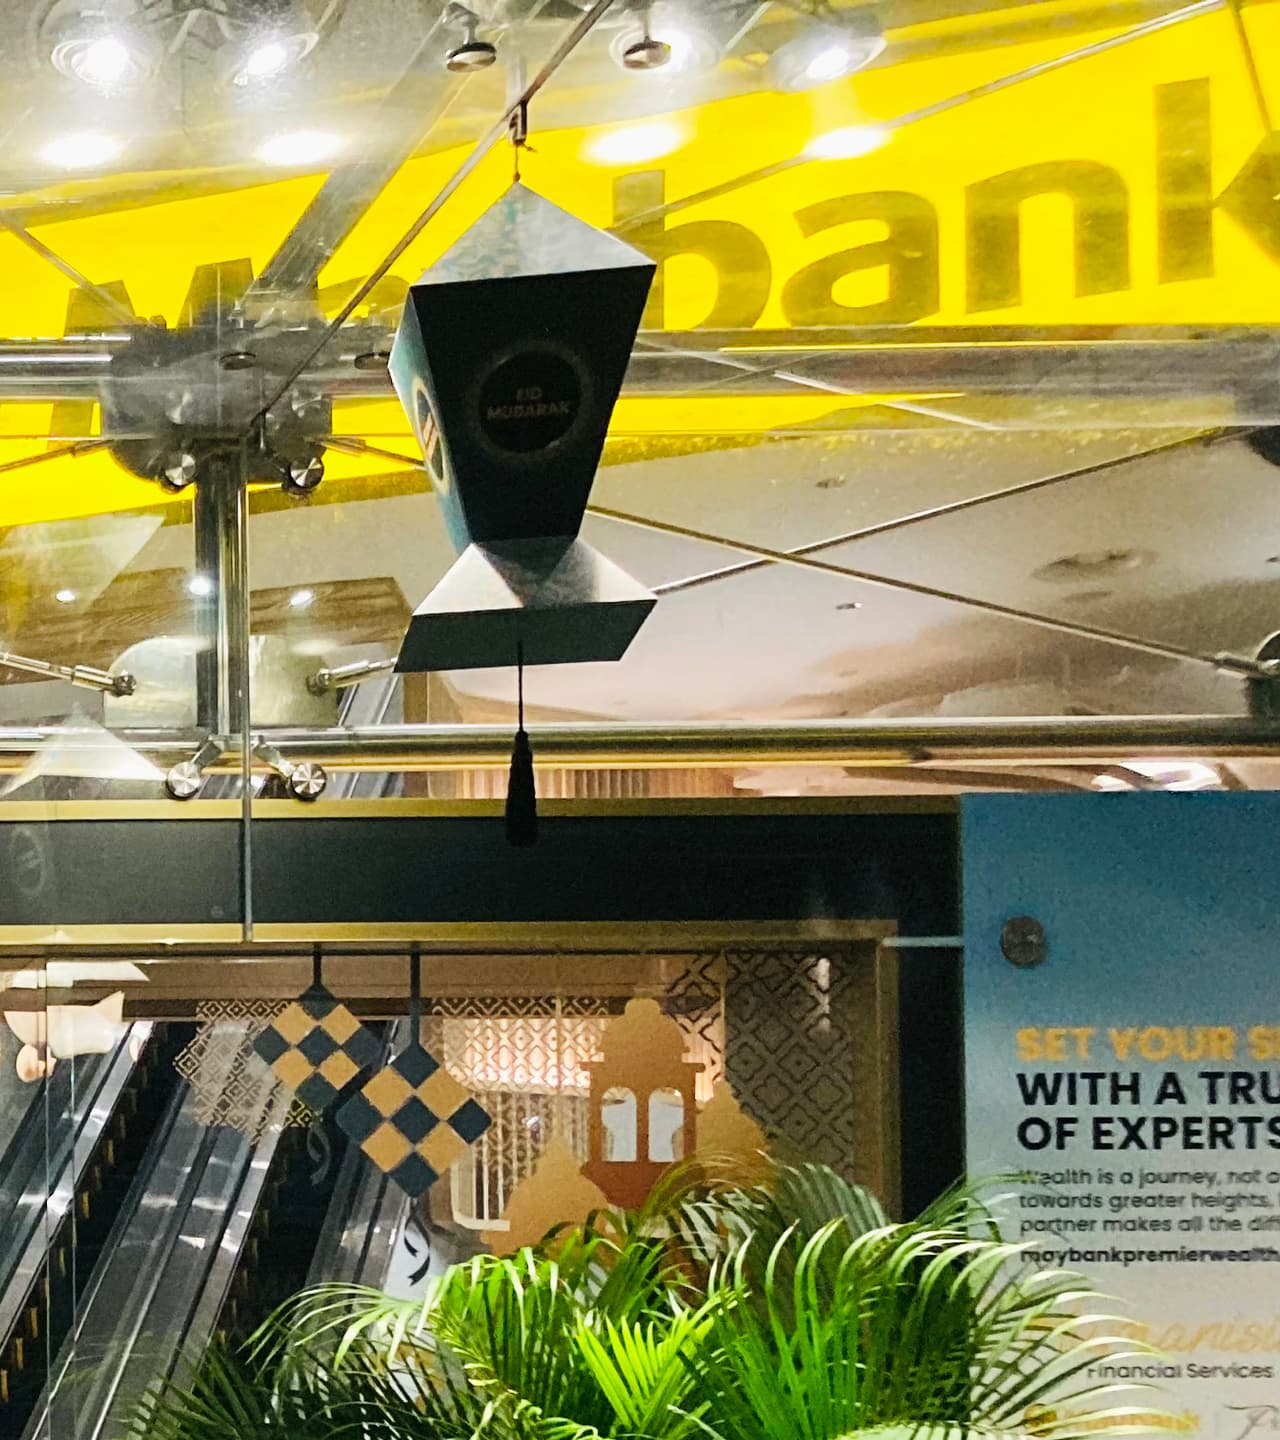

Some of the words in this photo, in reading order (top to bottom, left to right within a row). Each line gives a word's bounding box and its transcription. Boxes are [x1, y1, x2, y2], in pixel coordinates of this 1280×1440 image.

[1016, 1027, 1096, 1062] SET
[1108, 1026, 1235, 1061] YOUR
[1016, 1072, 1142, 1105] WITH
[1153, 1072, 1187, 1105] A
[1017, 1117, 1078, 1150] OF
[1097, 1169, 1114, 1185] is
[1120, 1173, 1134, 1185] a
[1227, 1169, 1261, 1185] not
[1019, 1193, 1104, 1209] towards
[1109, 1194, 1186, 1213] greater
[1020, 1216, 1098, 1237] partner
[1102, 1216, 1173, 1233] makes
[1177, 1215, 1204, 1233] all
[1208, 1216, 1242, 1233] the
[1187, 1362, 1275, 1379] Services
